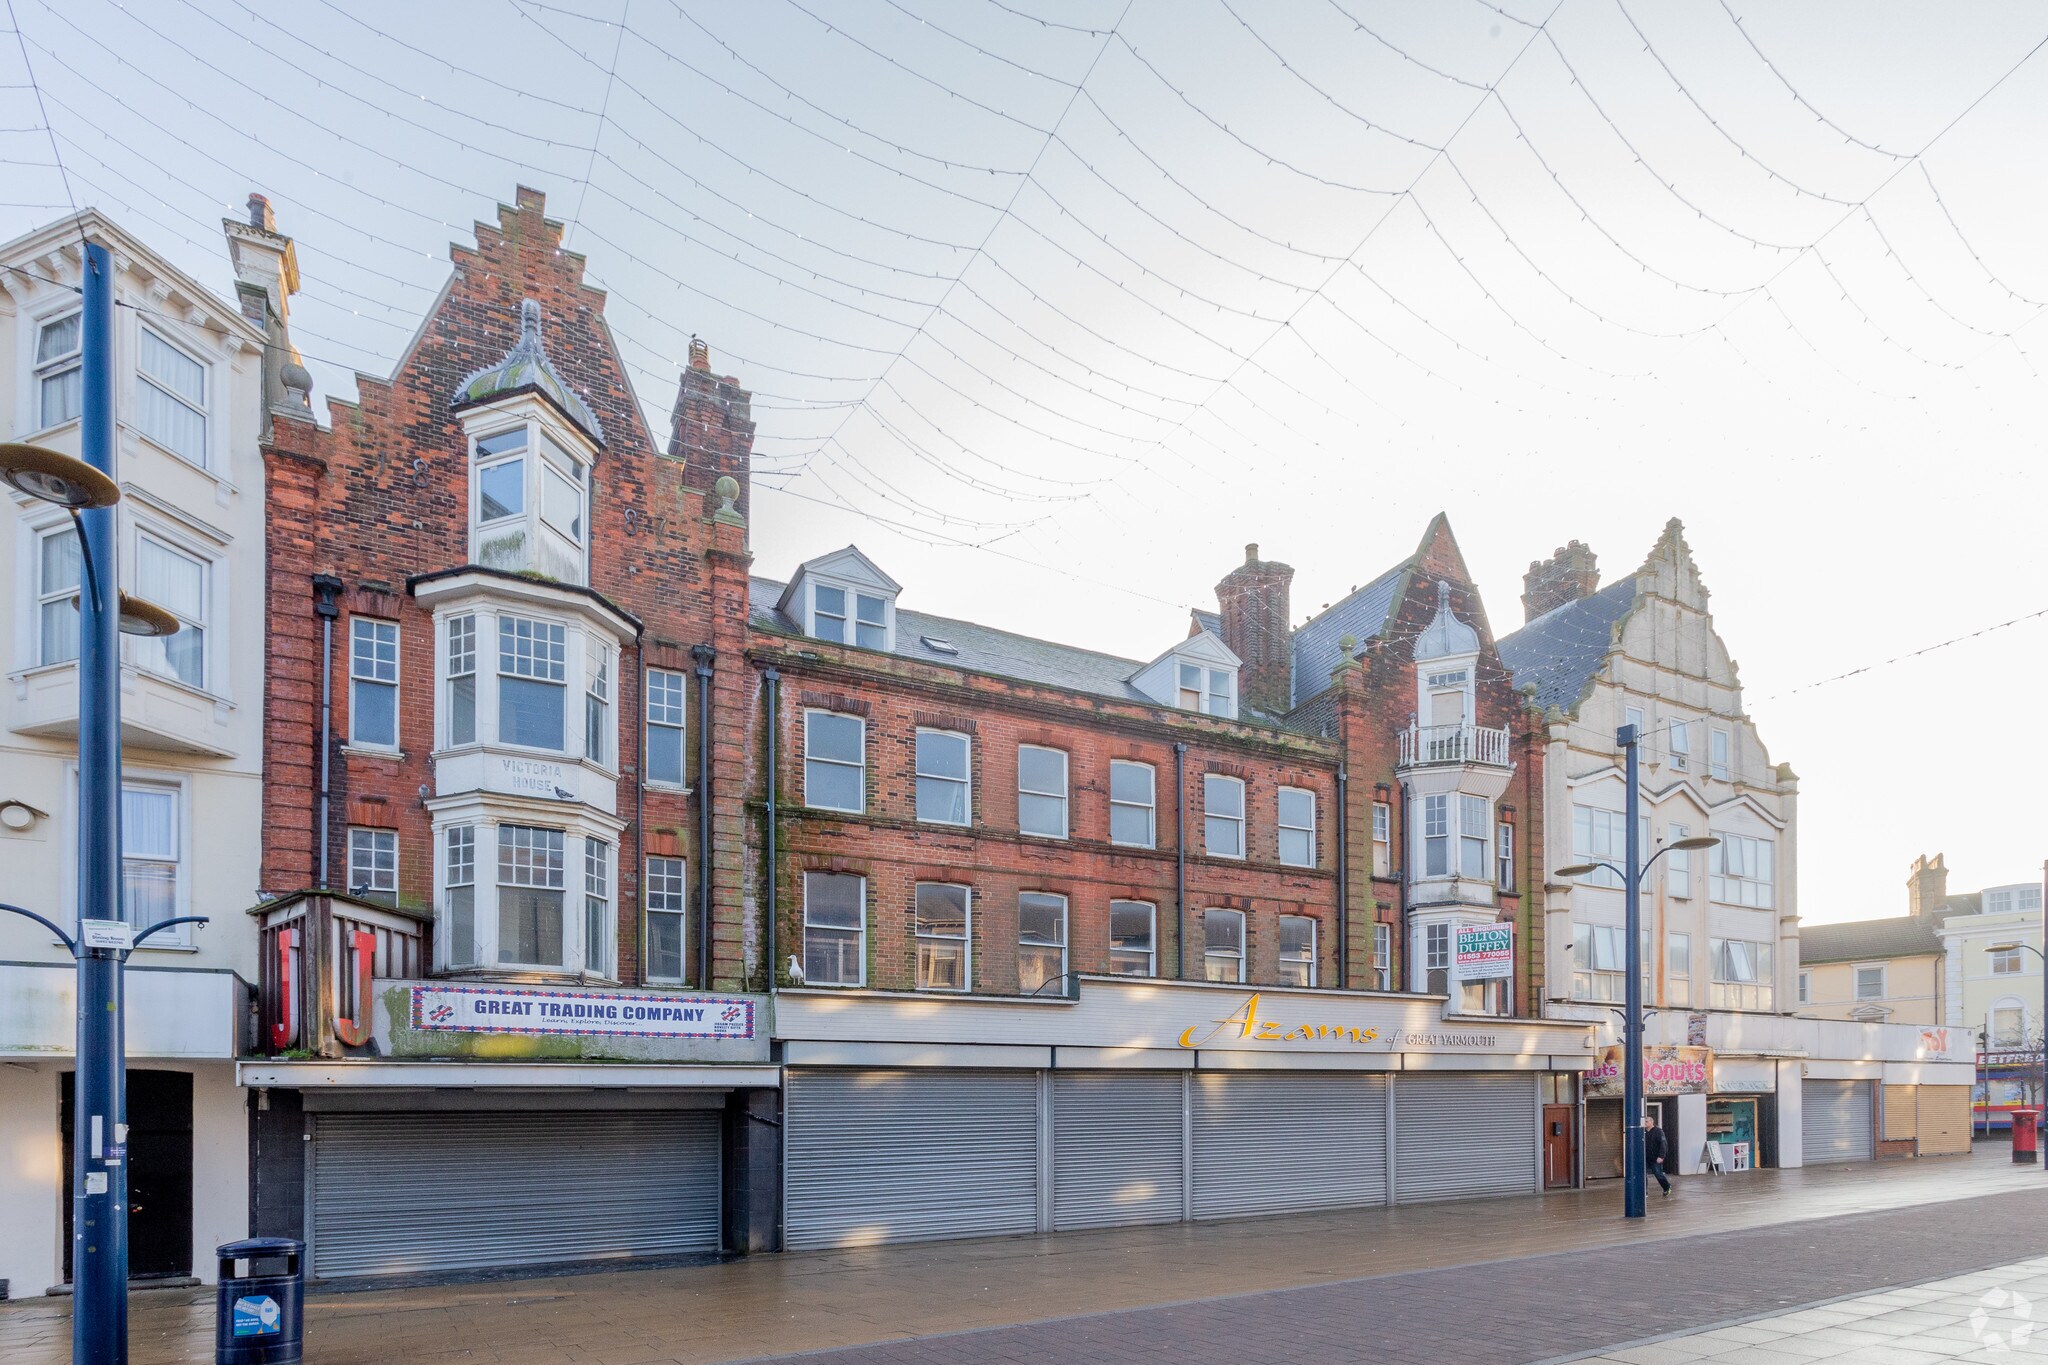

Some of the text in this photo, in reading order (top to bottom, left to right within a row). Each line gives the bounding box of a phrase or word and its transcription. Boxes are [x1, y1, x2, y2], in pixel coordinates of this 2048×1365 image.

[502, 760, 562, 778] VICTORIA
[512, 776, 552, 792] HOUSE
[1459, 930, 1509, 943] BELTON
[1459, 940, 1509, 954] DUFFEY
[474, 999, 705, 1022] GREAT TRADING COMPANY
[1178, 992, 1497, 1051] Azams of GREAT YARMOUTH
